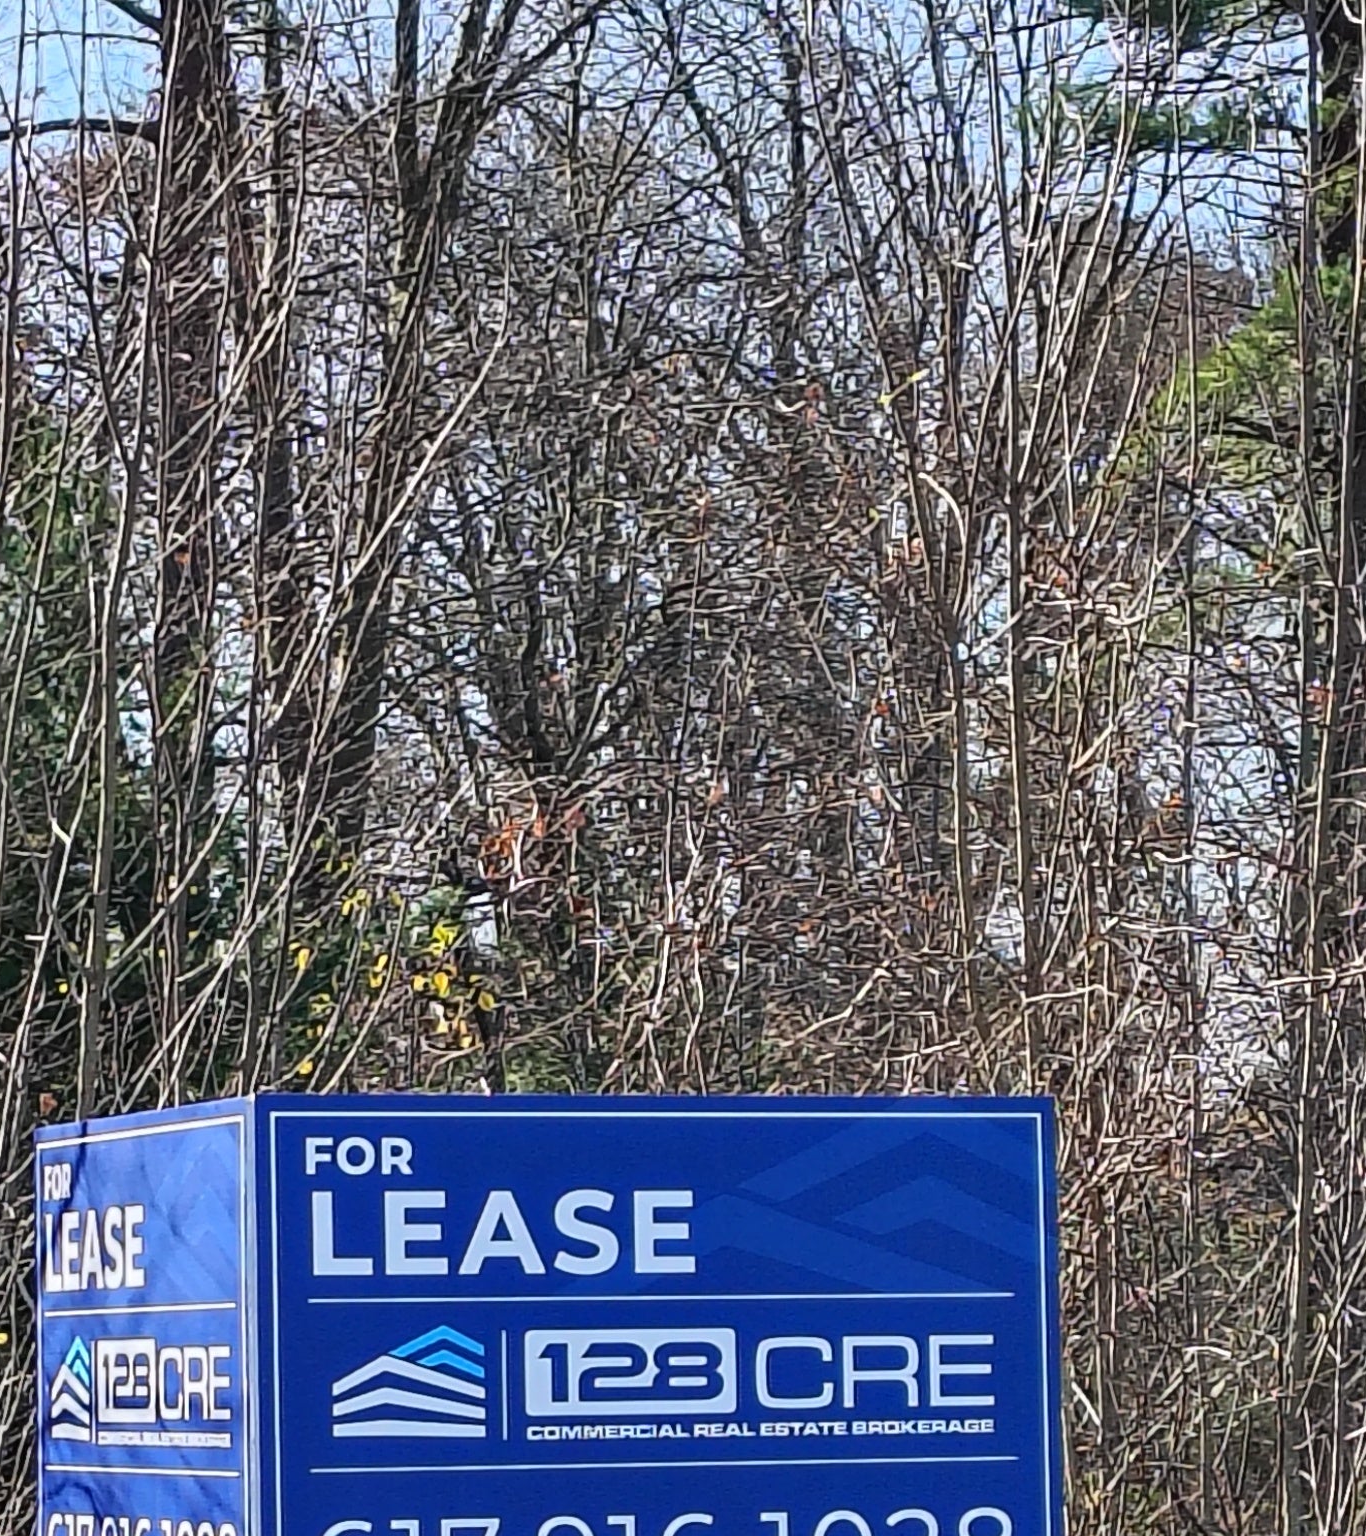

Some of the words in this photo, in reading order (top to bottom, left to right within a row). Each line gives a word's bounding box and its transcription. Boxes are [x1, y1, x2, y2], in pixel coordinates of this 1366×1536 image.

[43, 1162, 72, 1202] FOR
[304, 1135, 414, 1176] FOR
[44, 1203, 146, 1293] LEASE
[311, 1188, 697, 1277] LEASE
[158, 1345, 232, 1422] CRE
[537, 1340, 726, 1404] 128
[755, 1333, 996, 1410] CRE
[526, 1422, 690, 1441] COMMERCIAL
[693, 1421, 757, 1439] REAL
[759, 1420, 850, 1438] ESTATE
[851, 1418, 996, 1436] BROKERAGE
